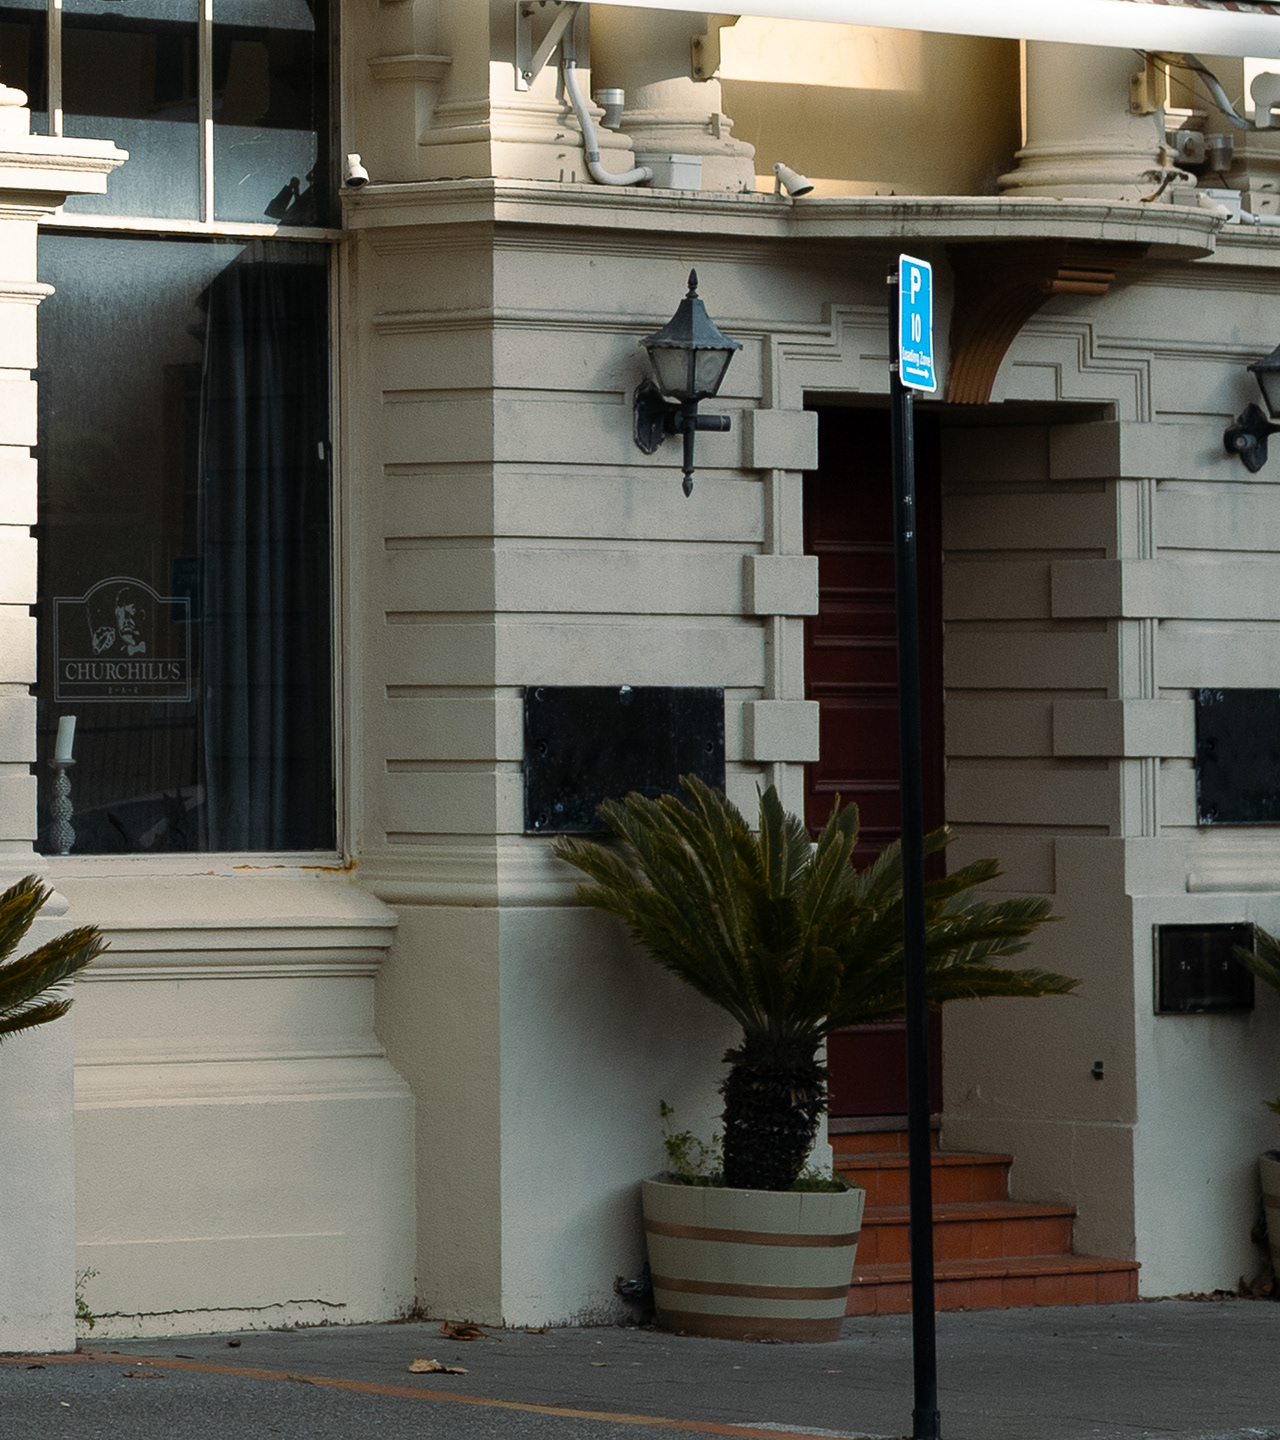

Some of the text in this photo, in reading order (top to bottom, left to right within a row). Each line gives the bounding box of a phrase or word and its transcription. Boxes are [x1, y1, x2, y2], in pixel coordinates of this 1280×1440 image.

[910, 266, 921, 304] P
[911, 312, 921, 343] 10
[65, 663, 180, 680] CHURCHILL'S
